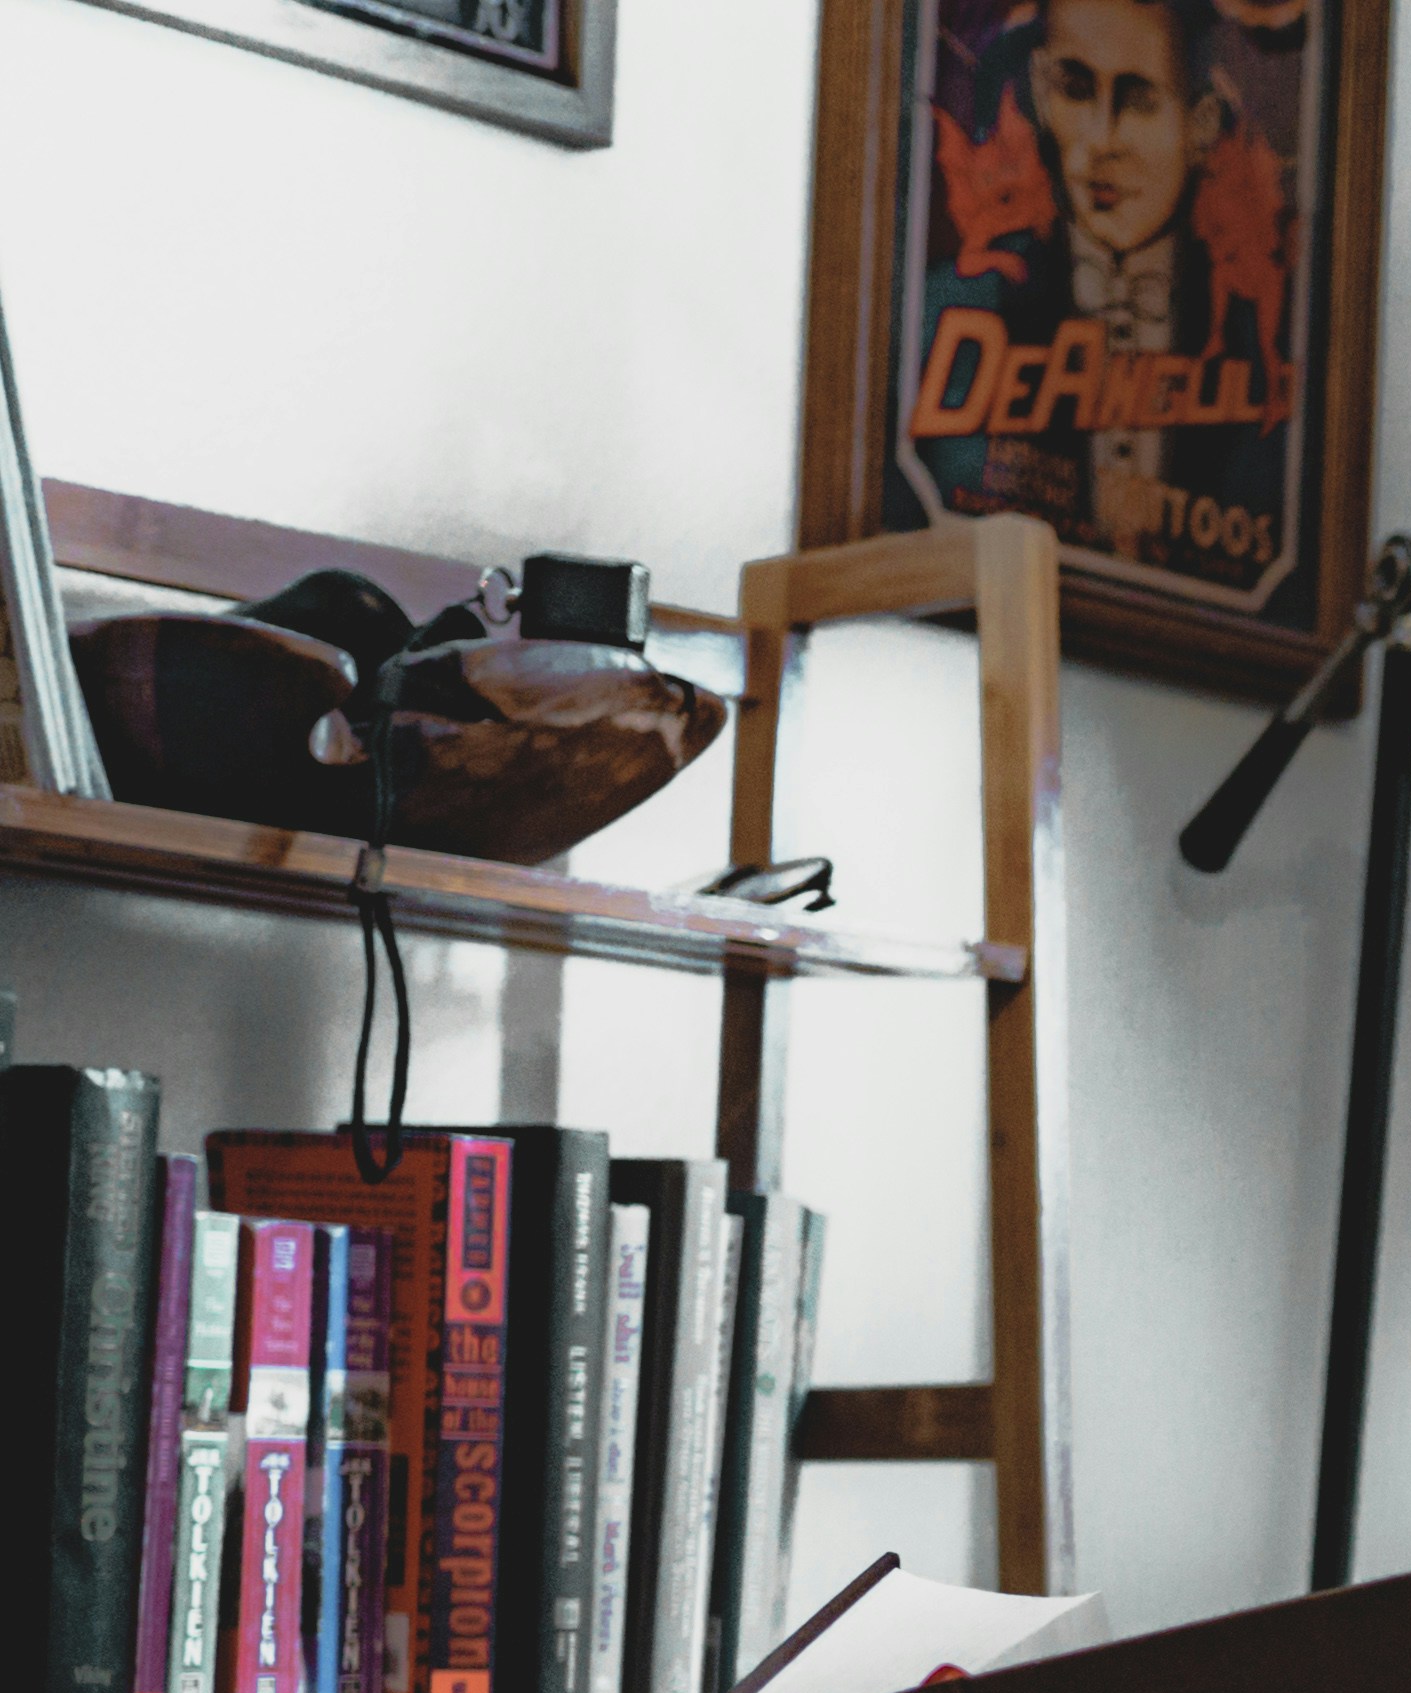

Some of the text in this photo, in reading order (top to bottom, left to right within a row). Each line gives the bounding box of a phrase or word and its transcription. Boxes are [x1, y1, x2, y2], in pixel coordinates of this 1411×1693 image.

[80, 1271, 137, 1542] Christine
[184, 1467, 213, 1667] TOLKIEN
[259, 1469, 284, 1667] TOLKIEN
[342, 1474, 366, 1672] TOLKIEN
[439, 1442, 496, 1670] scorpion
